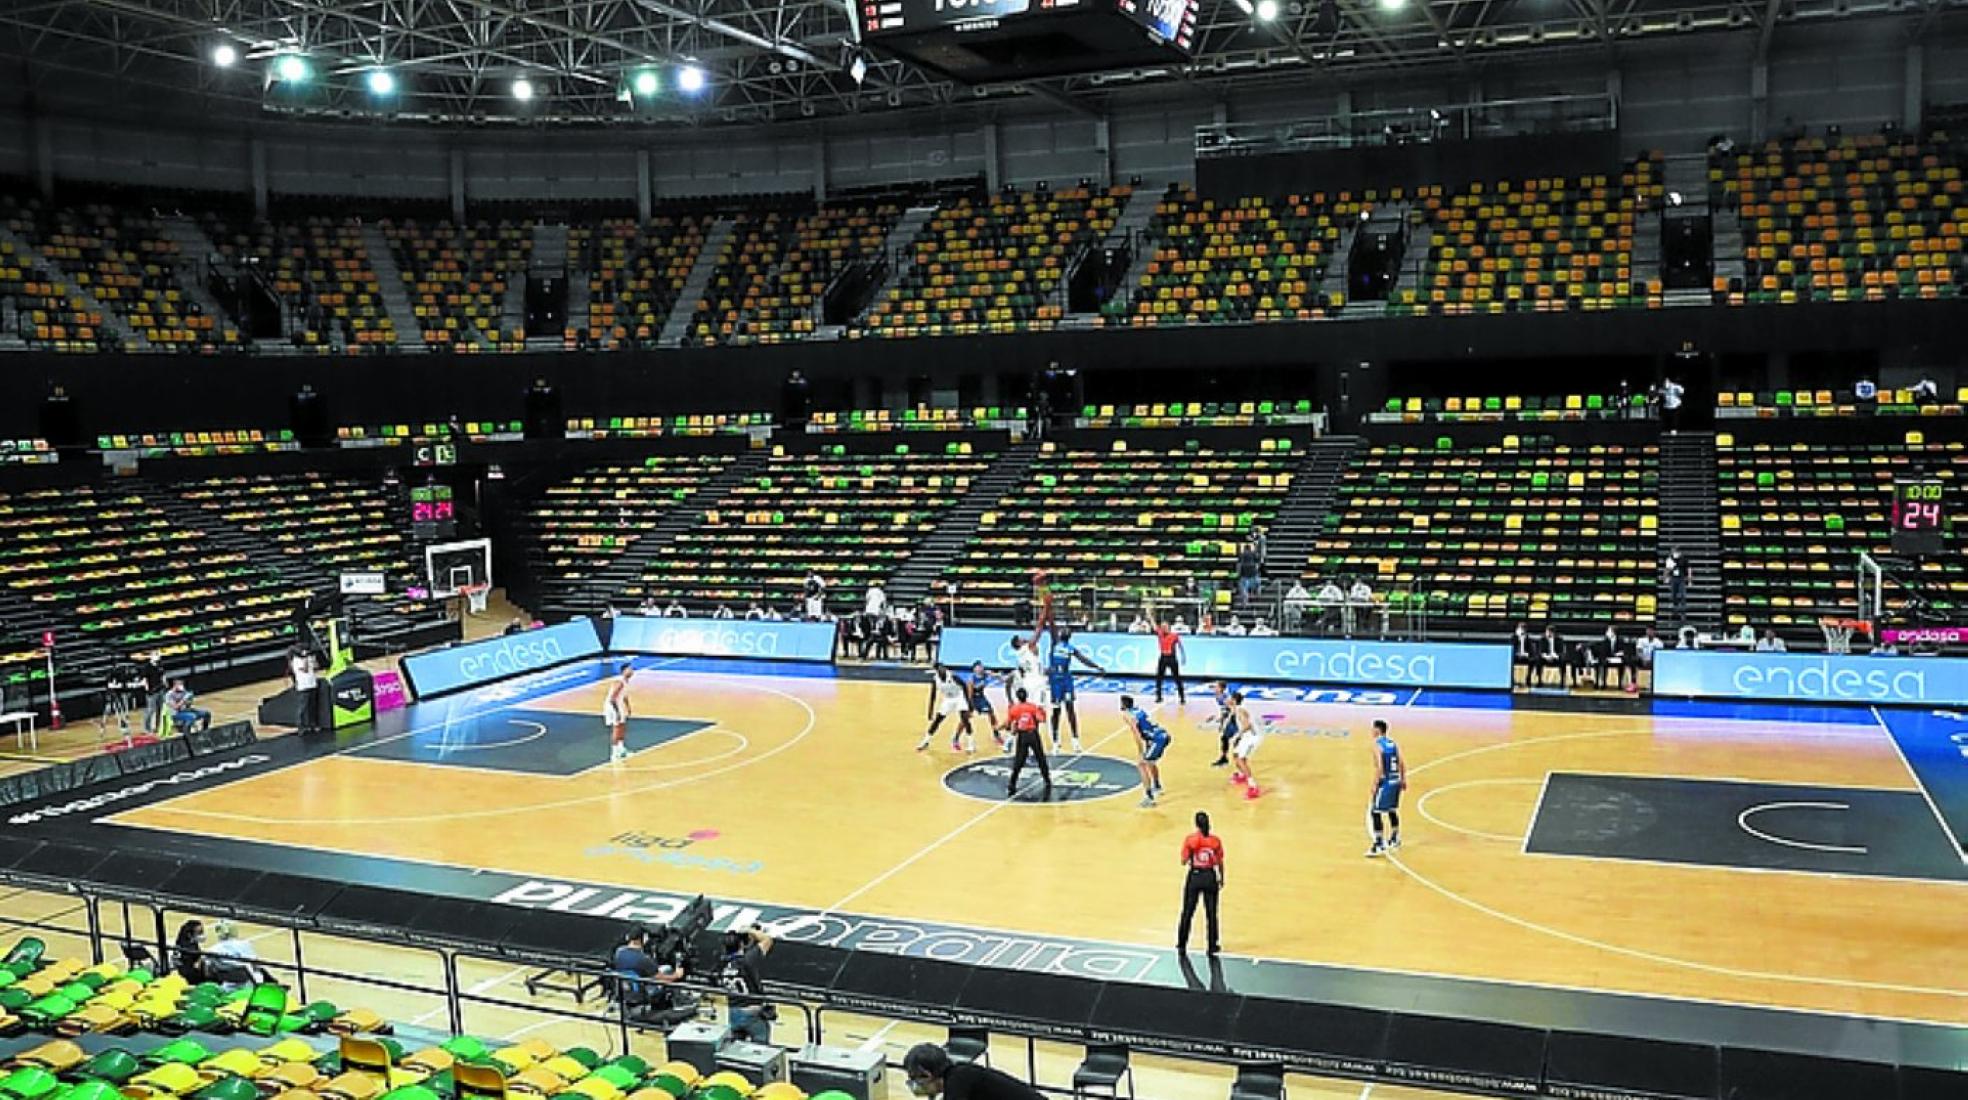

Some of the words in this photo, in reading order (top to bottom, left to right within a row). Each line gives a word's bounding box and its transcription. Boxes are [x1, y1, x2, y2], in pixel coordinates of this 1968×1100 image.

[413, 502, 432, 521] 24
[1903, 502, 1940, 529] 24
[1898, 630, 1960, 642] endesa
[460, 637, 562, 679] endesa
[1274, 645, 1435, 682] endesa
[1733, 659, 1925, 699] endesa
[609, 829, 695, 849] liga
